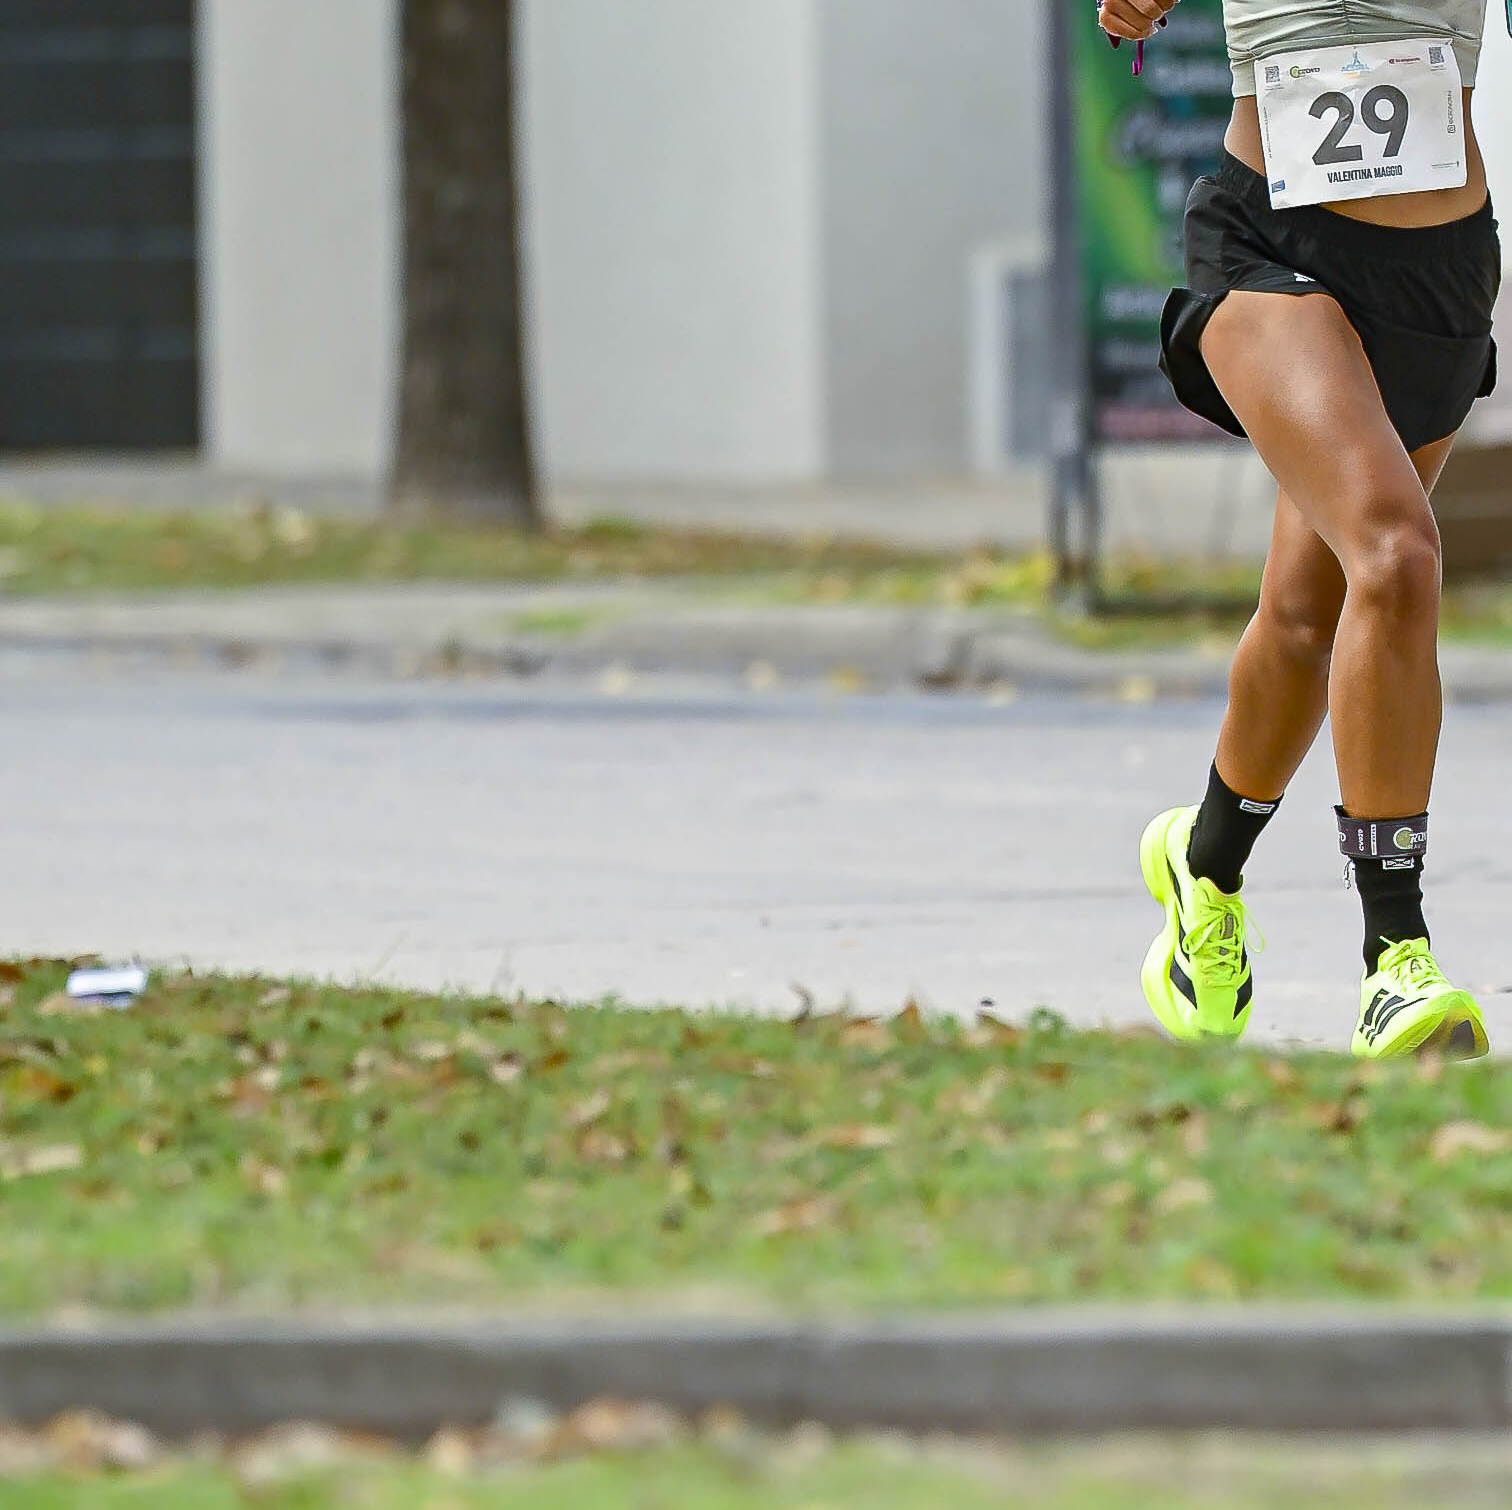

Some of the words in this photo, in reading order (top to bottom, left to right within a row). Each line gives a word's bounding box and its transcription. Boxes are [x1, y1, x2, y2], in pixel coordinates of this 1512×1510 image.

[1308, 84, 1409, 166] 29
[1327, 168, 1373, 184] VALENTINA
[1373, 164, 1403, 179] MAGGIO
